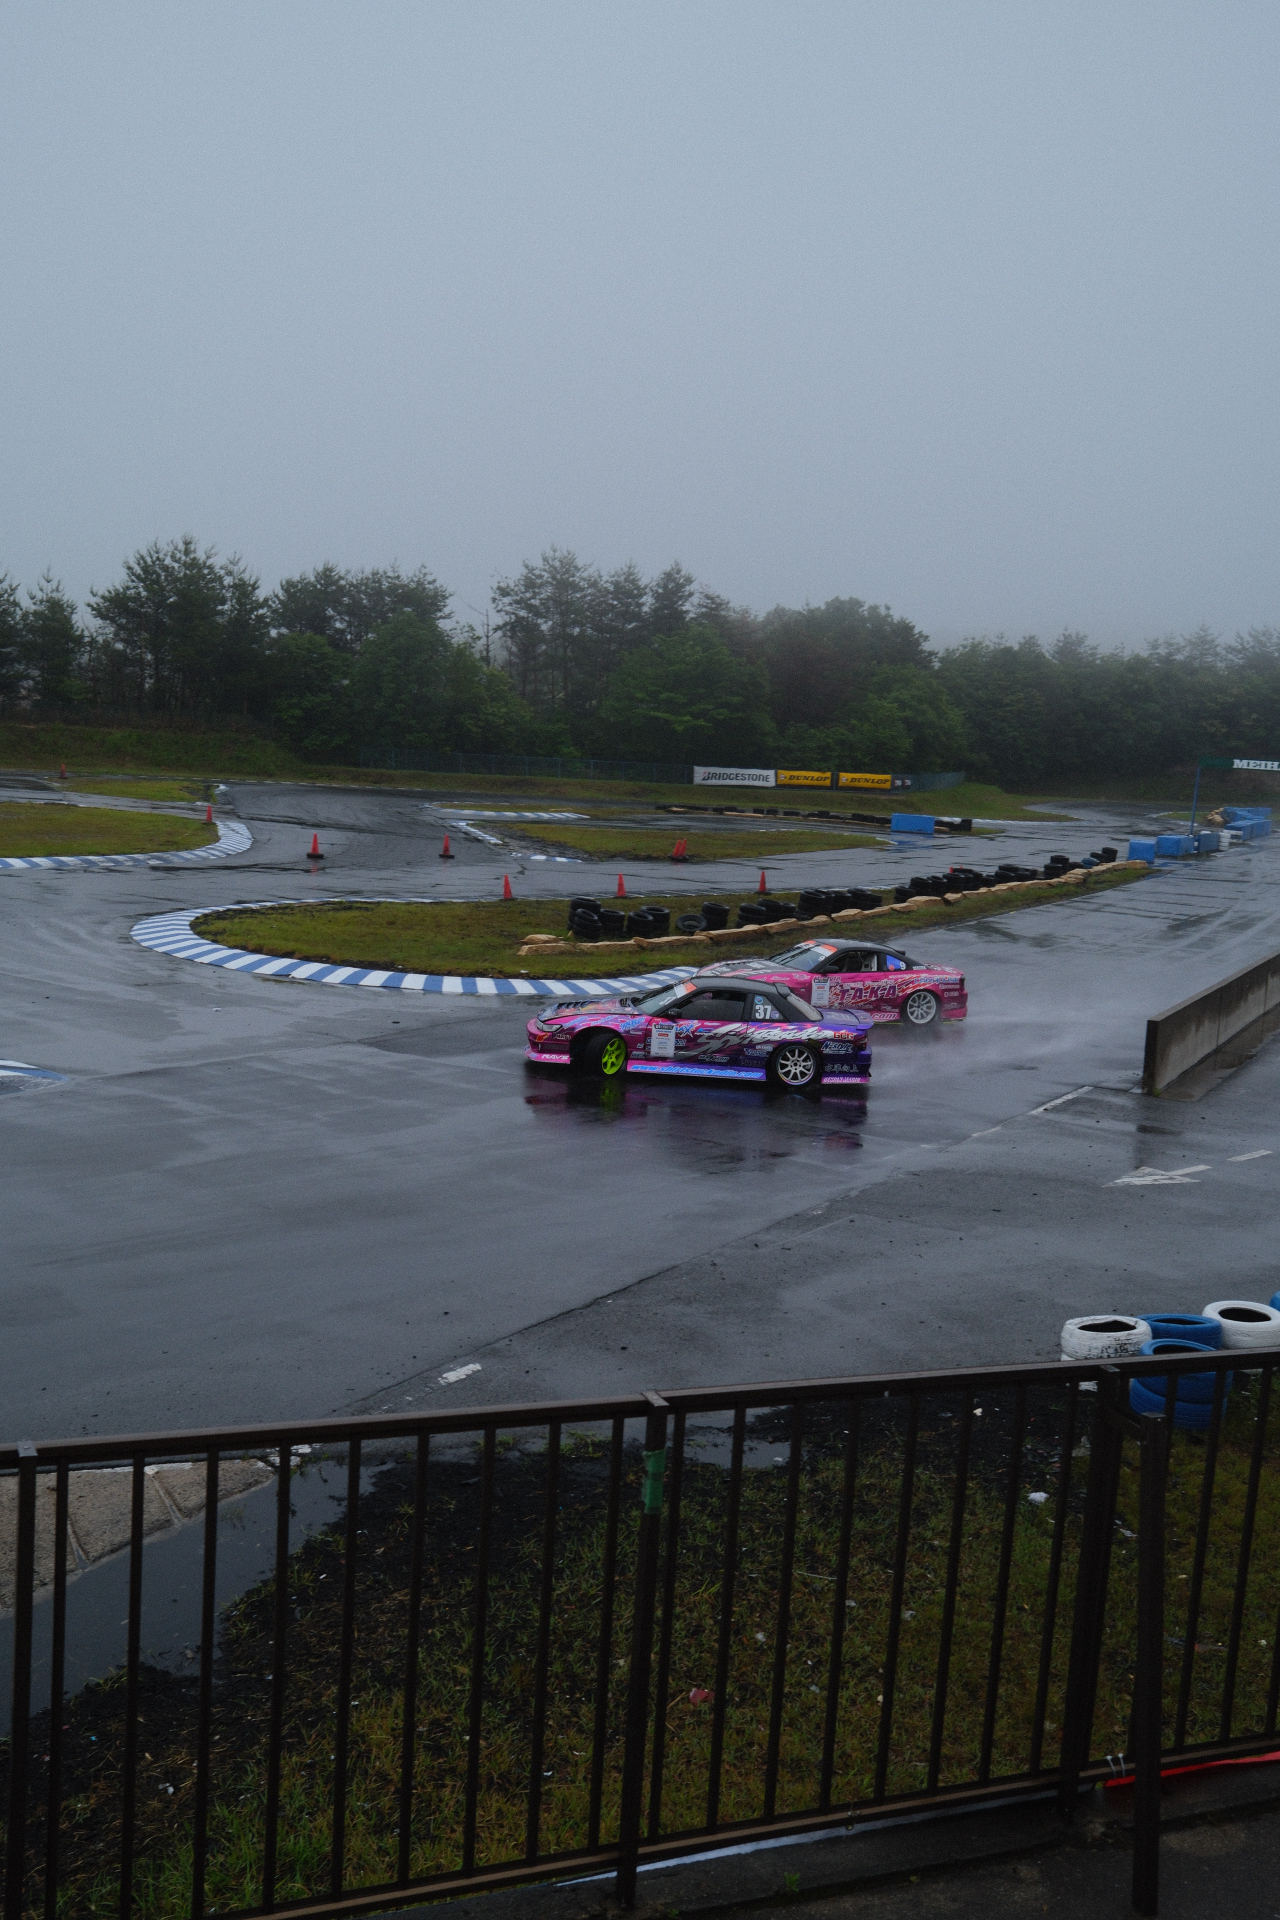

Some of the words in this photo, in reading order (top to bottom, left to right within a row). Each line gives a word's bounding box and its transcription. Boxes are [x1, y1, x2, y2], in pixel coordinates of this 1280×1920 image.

[1233, 759, 1280, 770] MEIH
[701, 771, 771, 783] BRIDGESTONE
[849, 777, 890, 785] DUNLOP
[899, 962, 907, 971] 9
[755, 1004, 772, 1020] 37
